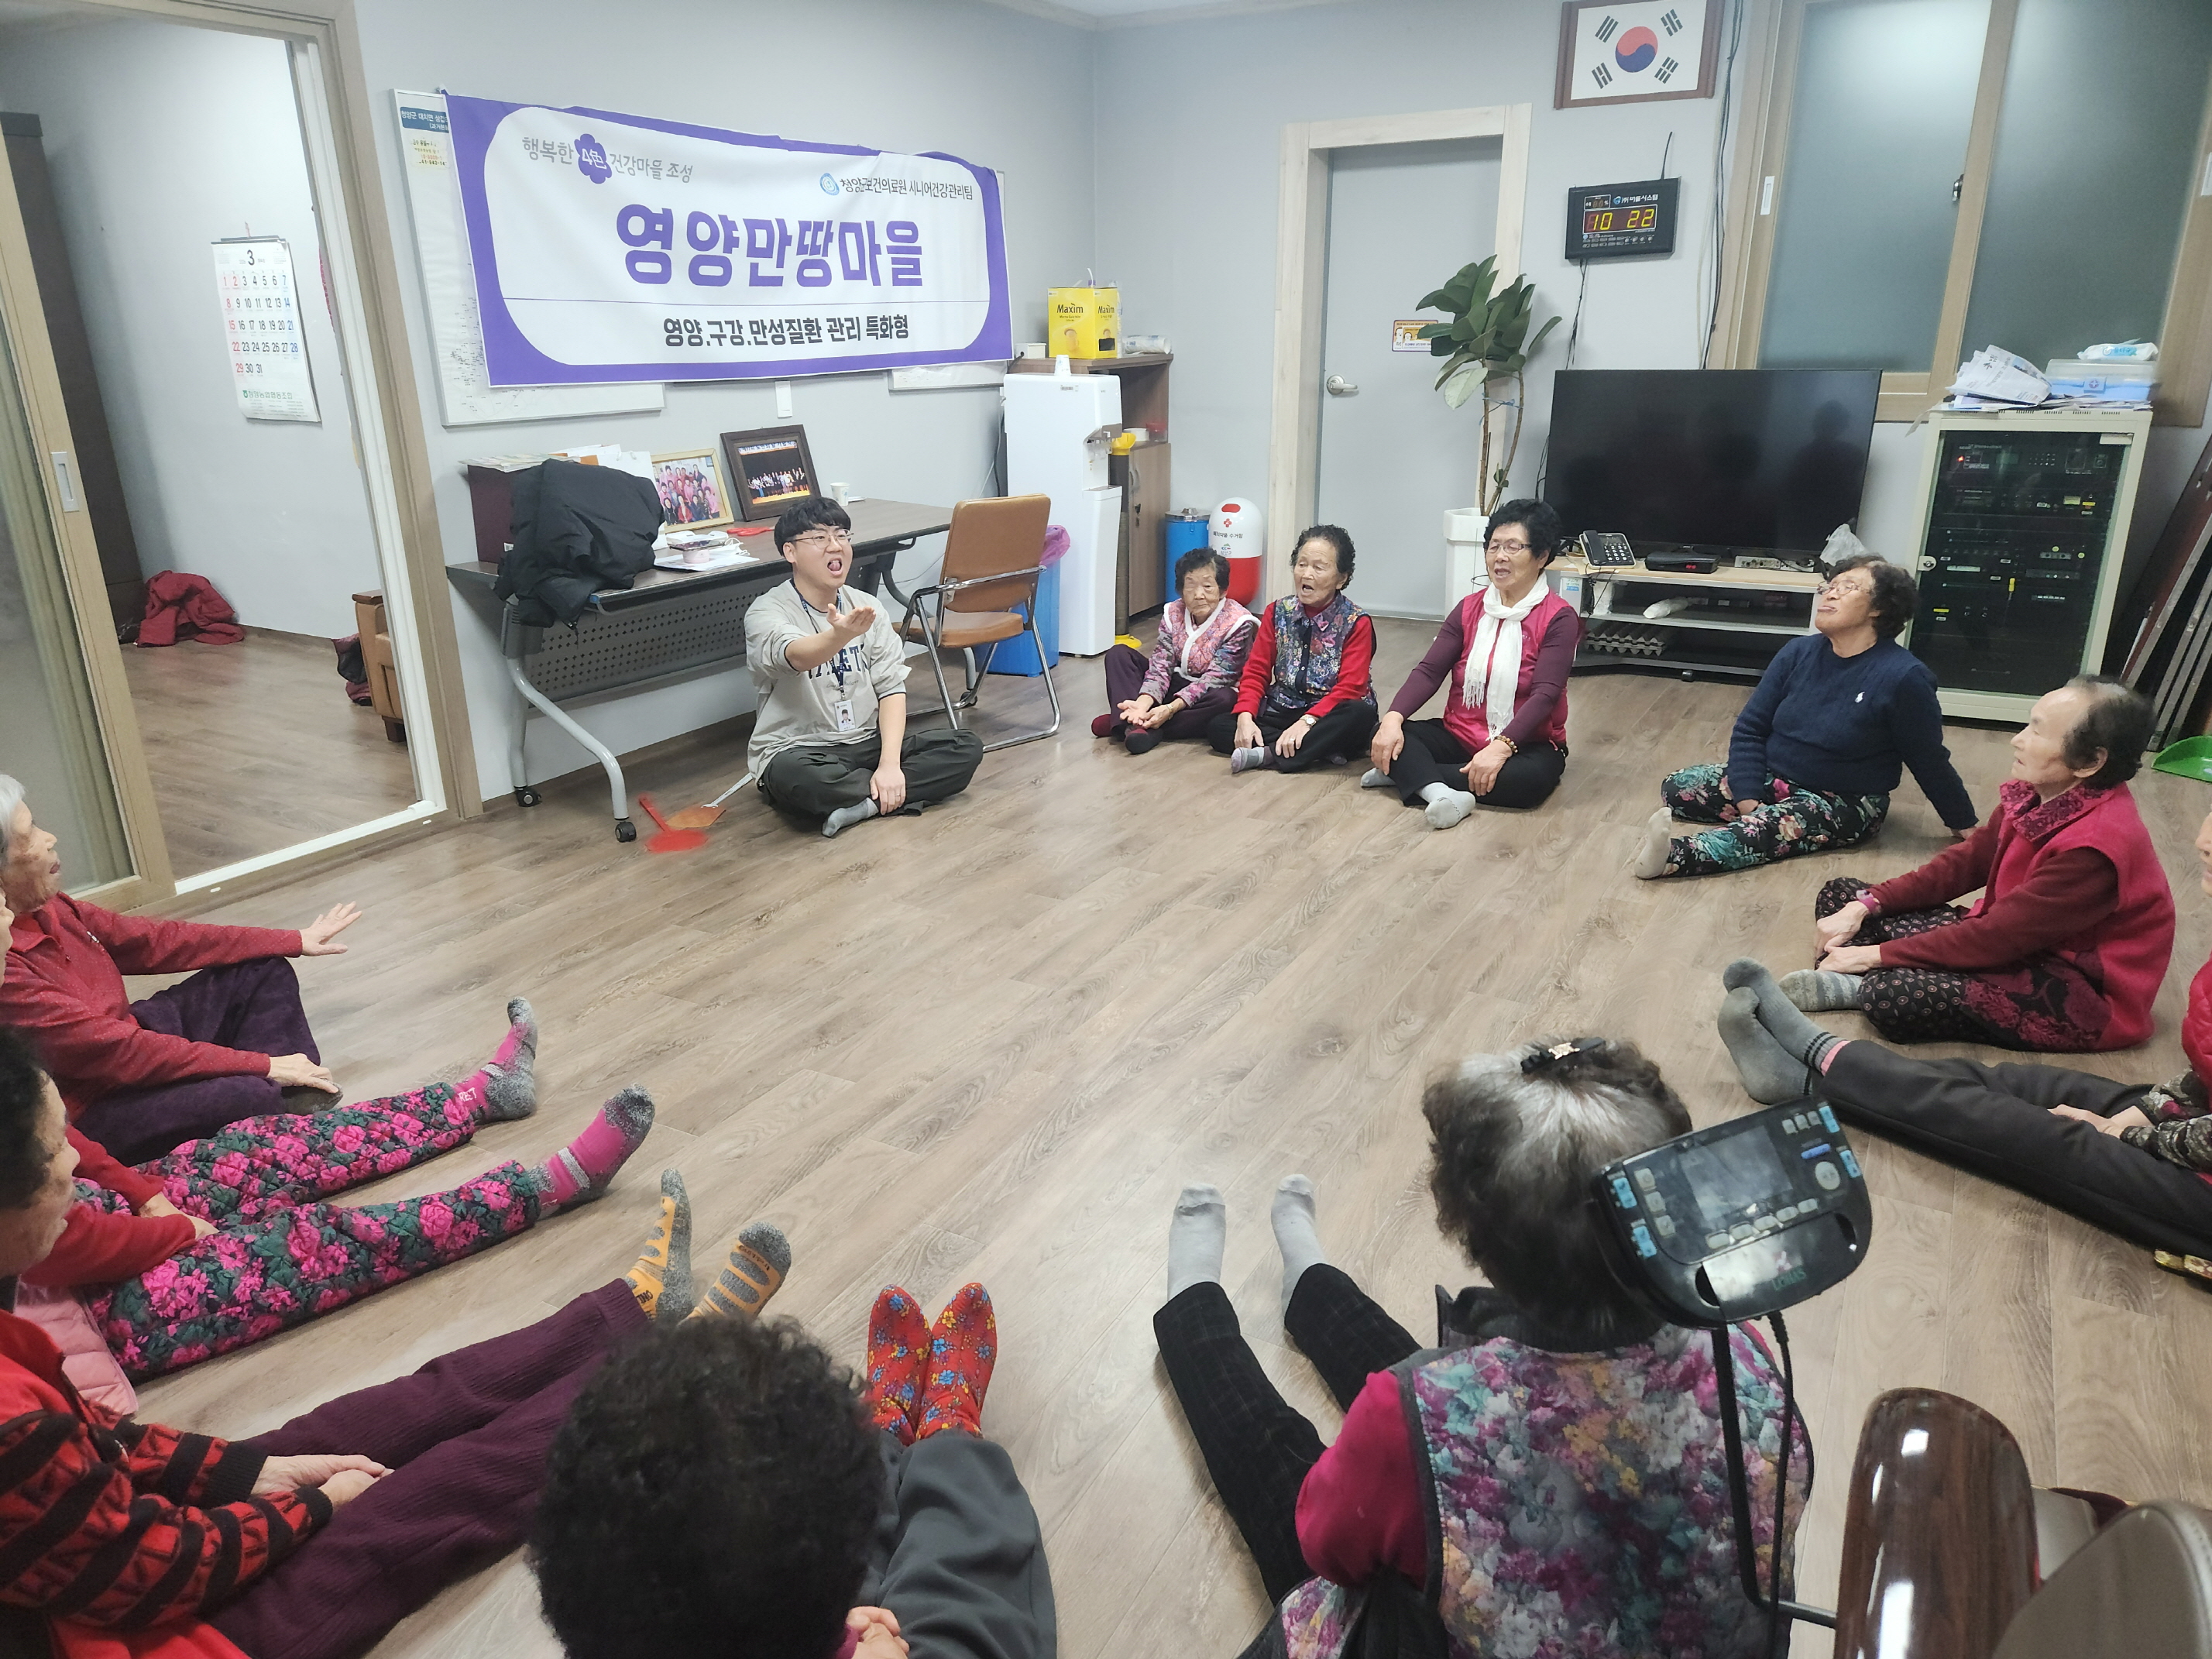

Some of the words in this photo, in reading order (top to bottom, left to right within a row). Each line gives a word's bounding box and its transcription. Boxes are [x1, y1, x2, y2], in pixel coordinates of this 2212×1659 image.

[522, 136, 574, 165] 행복한
[610, 153, 663, 180] 건강마을
[665, 163, 693, 184] 조성
[840, 177, 907, 194] 청양군보건의료원
[908, 180, 973, 200] 시니어건강관리팀
[1593, 212, 1613, 231] 10
[1627, 208, 1654, 228] 22
[616, 204, 923, 287] 영양만땅마을
[246, 249, 255, 266] 3
[223, 276, 227, 287] 1
[233, 276, 238, 287] 2
[242, 276, 248, 287] 3
[252, 276, 258, 287] 4
[263, 276, 267, 287] 5
[273, 276, 277, 287] 6
[282, 276, 287, 287] 7
[226, 298, 232, 308] 8
[236, 298, 241, 308] 9
[244, 298, 252, 308] 10
[255, 298, 262, 308] 11
[265, 298, 273, 308] 12
[275, 298, 282, 308] 13
[283, 298, 290, 308] 14
[1056, 303, 1084, 314] Maxim
[1097, 304, 1115, 314] Maxim
[228, 320, 235, 331] 15
[238, 320, 246, 331] 16
[249, 320, 256, 331] 17
[259, 320, 266, 331] 18
[269, 320, 276, 331] 19
[278, 320, 286, 331] 20
[287, 320, 294, 331] 21
[663, 318, 823, 347] 영양.구강.만성질환
[827, 316, 861, 342] 관리
[866, 314, 909, 340] 특화형
[232, 342, 241, 352] 22
[242, 342, 250, 352] 23
[252, 342, 260, 352] 24
[262, 342, 270, 352] 25
[272, 342, 280, 352] 26
[281, 342, 288, 352] 27
[290, 342, 299, 352] 28
[235, 363, 244, 374] 29
[246, 363, 254, 374] 30
[256, 363, 263, 374] 31
